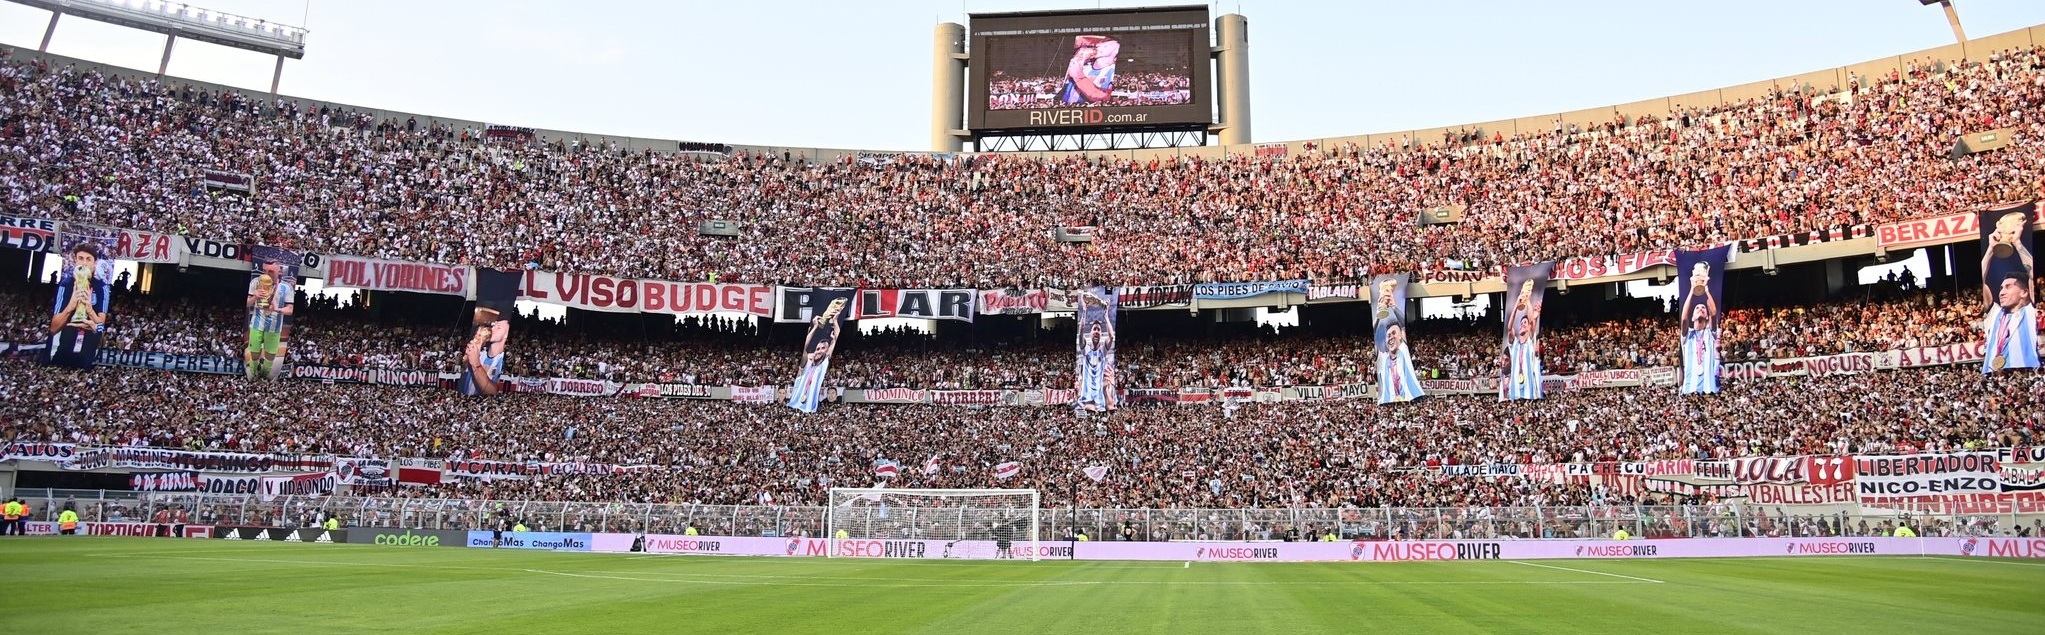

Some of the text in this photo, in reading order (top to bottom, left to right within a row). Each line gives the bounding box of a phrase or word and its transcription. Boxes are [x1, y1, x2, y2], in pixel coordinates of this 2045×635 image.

[328, 259, 466, 293] POLVORINES
[555, 272, 638, 307] VISO
[1195, 286, 1214, 296] LOS
[1217, 284, 1248, 296] PIBES
[1251, 283, 1265, 293] DE
[1308, 285, 1357, 299] TABLADA
[644, 282, 771, 315] BUDGE
[783, 287, 972, 323] PLAR
[162, 353, 246, 374] PEREYRA
[1805, 354, 1872, 377] NOGUES
[560, 381, 604, 394] DORREGO
[660, 383, 672, 395] LOS
[673, 384, 691, 396] PIBES
[692, 385, 704, 396] DEL
[1296, 384, 1368, 398] VILLA DE MAYO
[930, 391, 1000, 405] LAFERRERE
[116, 449, 173, 464] MARTINEZ
[399, 458, 442, 469] LOS PIBES
[1735, 458, 1843, 482] LOLA 77
[1857, 454, 1996, 477] LIBERTADOR
[134, 472, 195, 491] 9 DE ABRIL
[1861, 477, 1997, 494] NICO-ENZO
[1750, 482, 1854, 504] V.BALLESTER
[375, 530, 439, 546] codere
[472, 537, 524, 547] ChanoMas
[532, 539, 584, 549] ChangoMas
[1010, 545, 1073, 557] MUSORIVER
